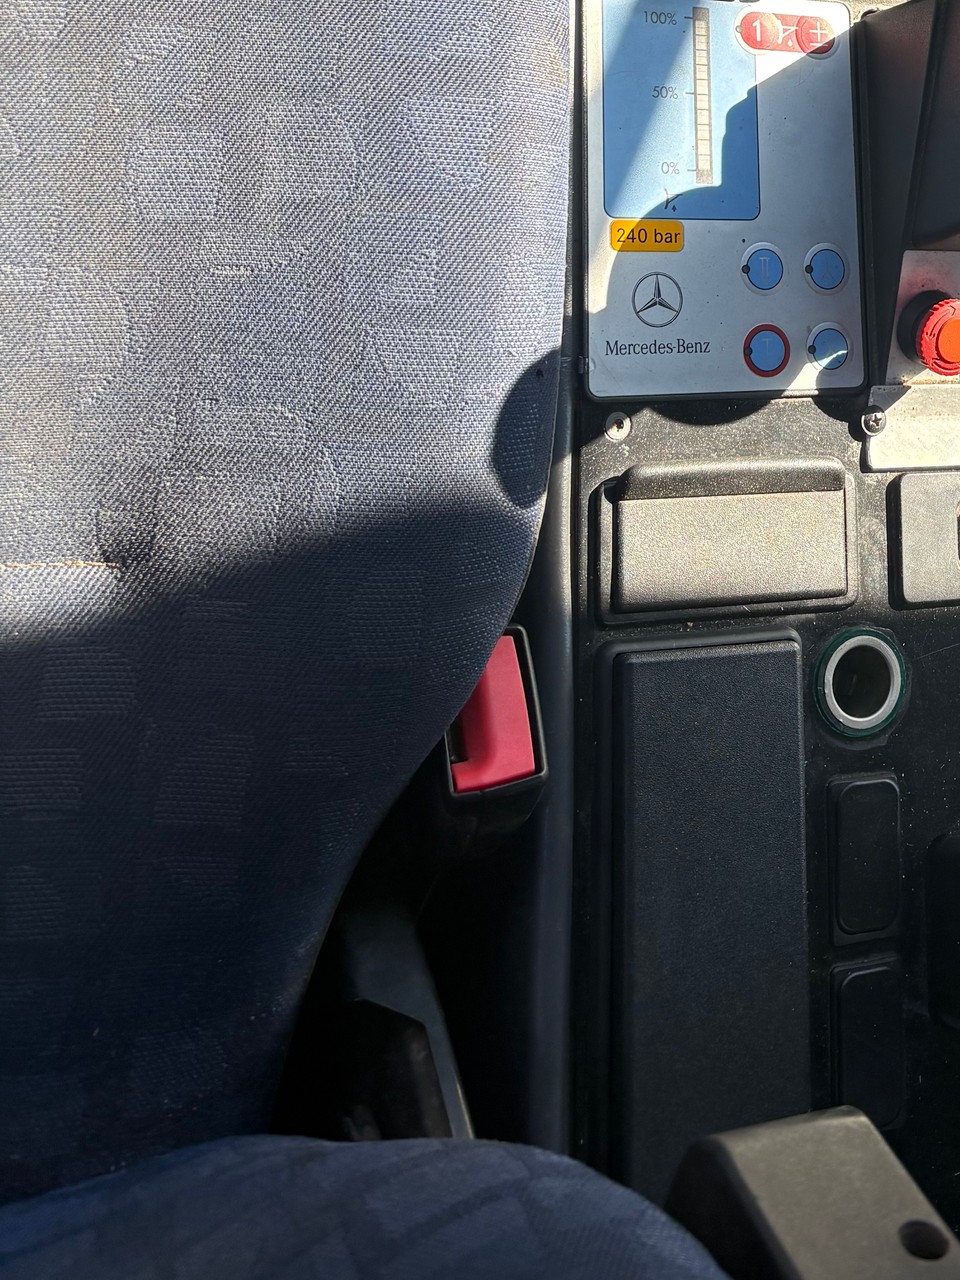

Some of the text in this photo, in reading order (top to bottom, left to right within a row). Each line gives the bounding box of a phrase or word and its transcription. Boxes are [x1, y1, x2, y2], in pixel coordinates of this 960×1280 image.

[643, 10, 678, 26] 100%
[752, 19, 762, 42] 1
[652, 85, 679, 100] 50%
[661, 161, 680, 175] 0%
[616, 228, 681, 244] 240 bar
[605, 338, 711, 356] Mercedes-Benz
